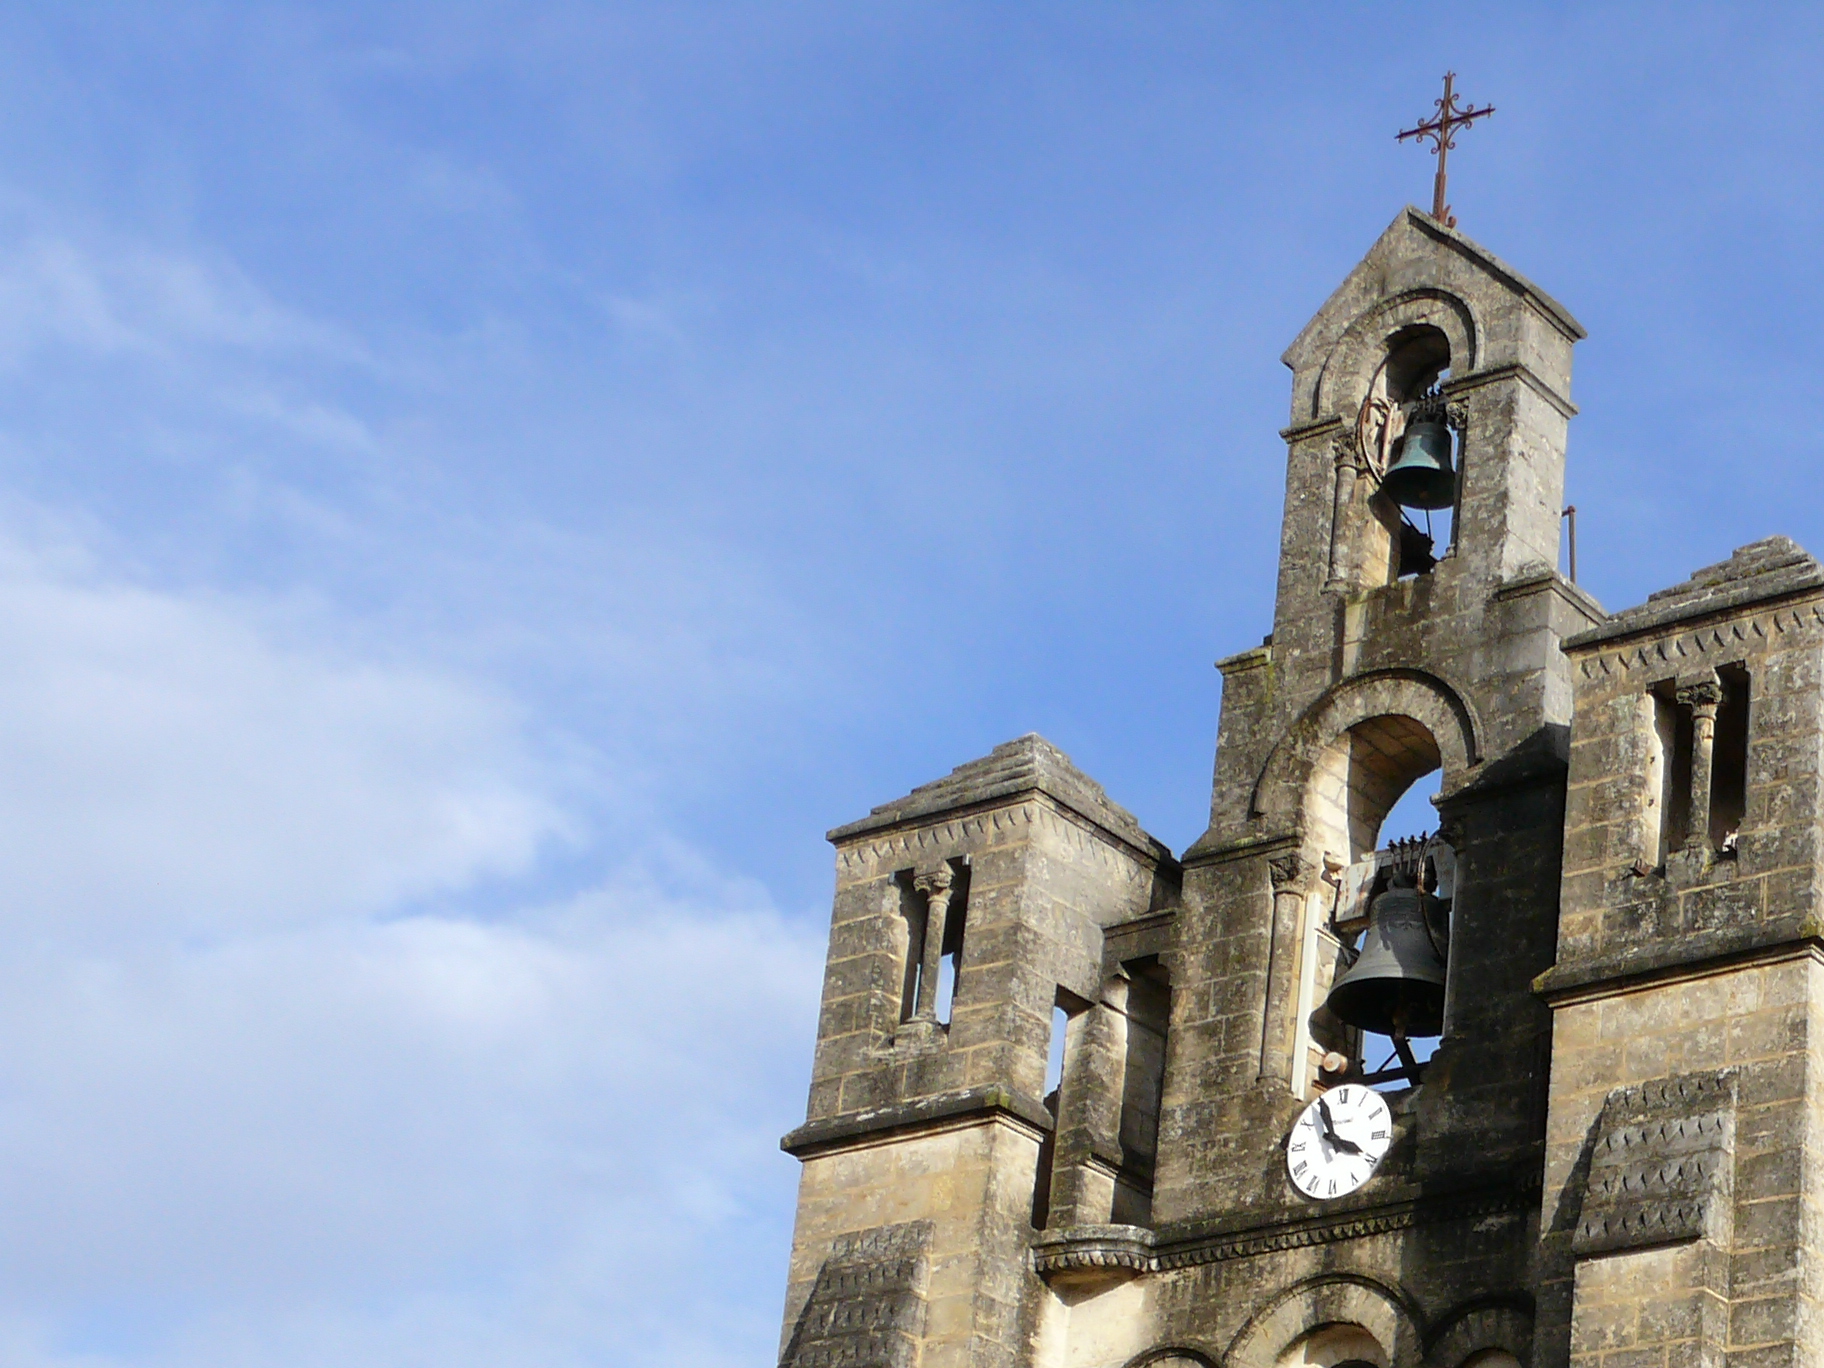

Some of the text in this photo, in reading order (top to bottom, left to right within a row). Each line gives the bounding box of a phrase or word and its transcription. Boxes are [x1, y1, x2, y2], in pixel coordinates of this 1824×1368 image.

[1338, 1088, 1349, 1105] XII
[1368, 1107, 1383, 1120] II
[1371, 1130, 1386, 1140] III
